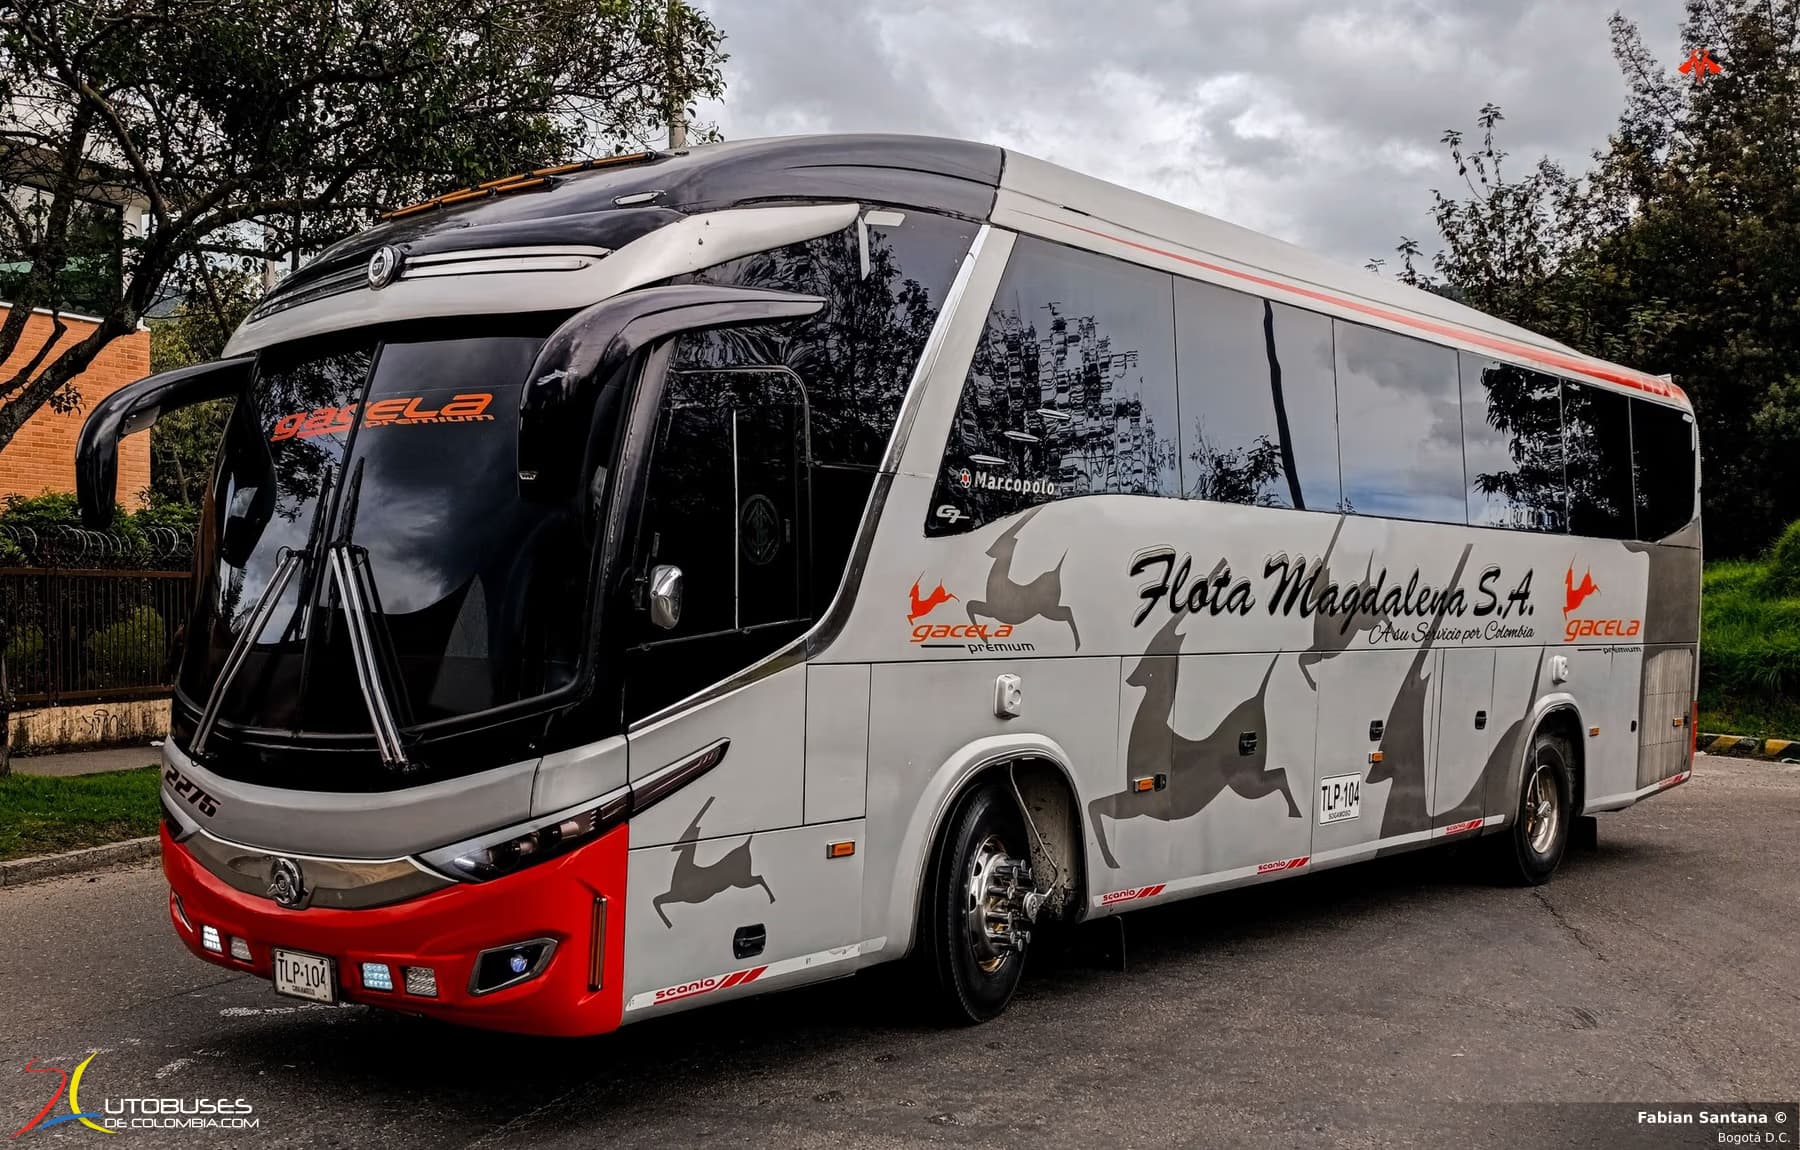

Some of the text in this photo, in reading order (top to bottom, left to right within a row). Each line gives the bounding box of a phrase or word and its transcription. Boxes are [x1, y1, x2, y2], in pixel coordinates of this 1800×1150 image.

[974, 471, 1055, 495] Marcopolo
[1129, 544, 1535, 635] Flota Magdalena S.A.
[1393, 629, 1409, 641] su
[1411, 621, 1462, 643] Servicio
[1462, 627, 1482, 645] por
[1484, 620, 1535, 641] Colombia
[967, 643, 1036, 655] premium
[165, 764, 221, 818] 2276
